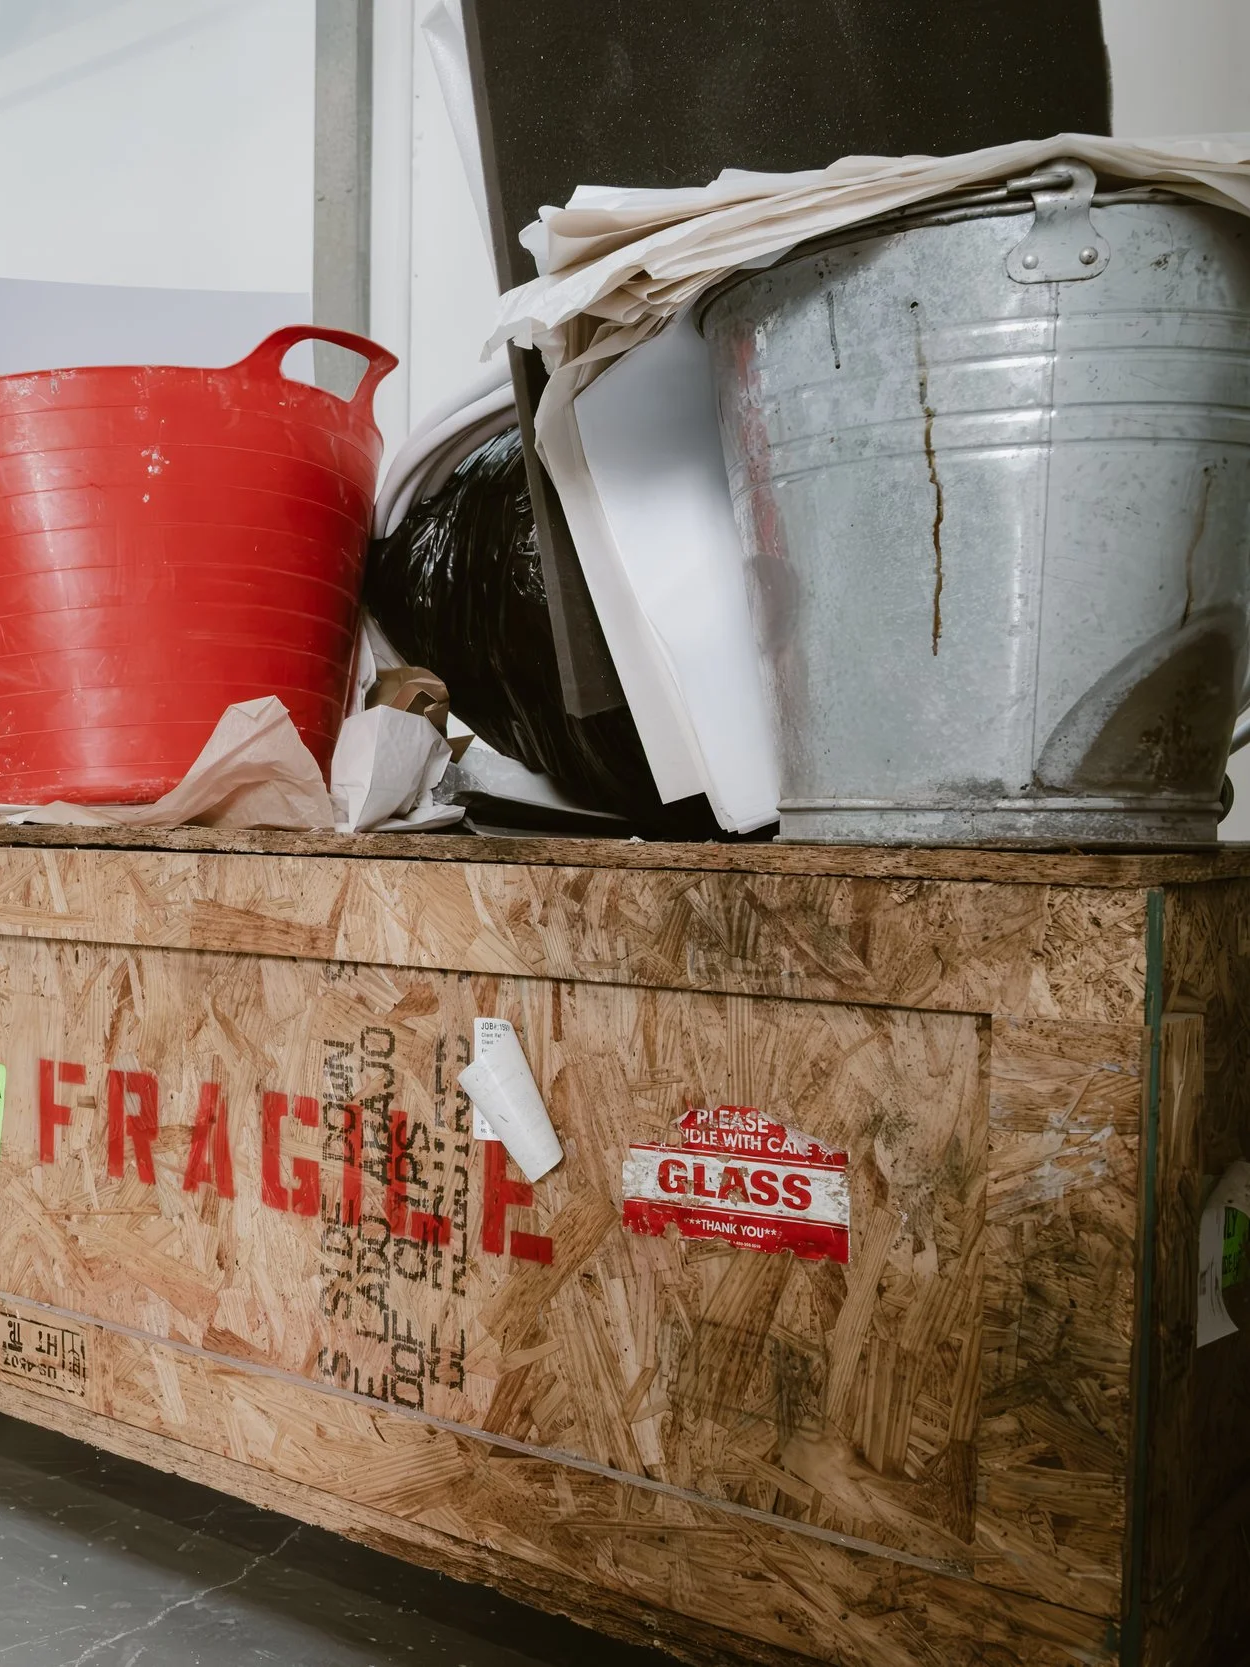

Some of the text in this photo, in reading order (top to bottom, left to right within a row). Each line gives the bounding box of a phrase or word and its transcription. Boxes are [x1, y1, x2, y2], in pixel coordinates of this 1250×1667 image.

[38, 1058, 554, 1265] FRAGILE
[322, 1039, 356, 1164] DOWN
[359, 1025, 396, 1186] ABAJO
[696, 1110, 769, 1134] PLEASE
[722, 1132, 762, 1151] WITH
[393, 1120, 431, 1283] CLIPS
[657, 1158, 813, 1211] GLASS
[319, 1193, 354, 1319] SIDE
[355, 1214, 391, 1342] LADO
